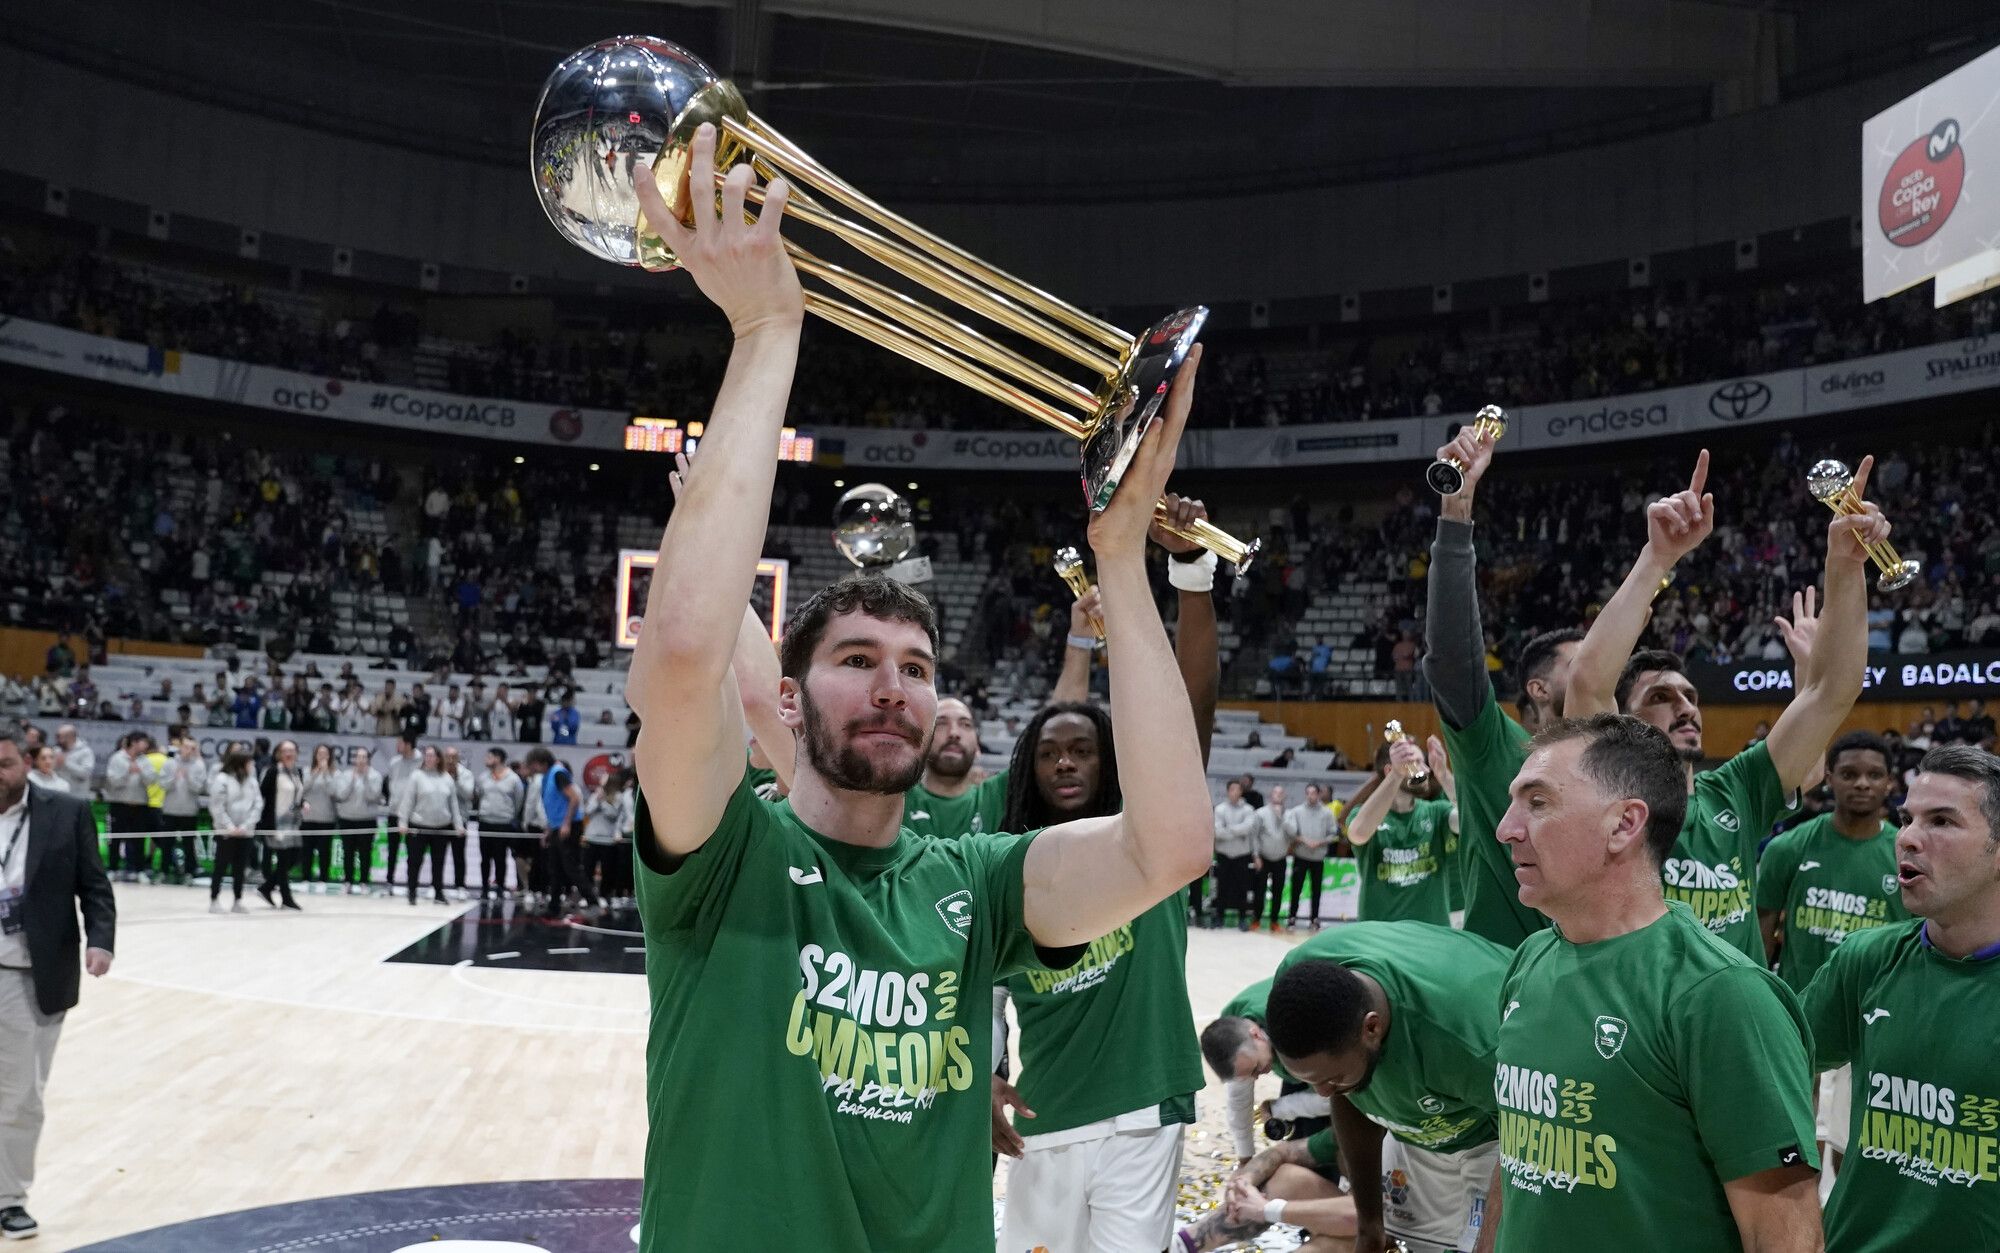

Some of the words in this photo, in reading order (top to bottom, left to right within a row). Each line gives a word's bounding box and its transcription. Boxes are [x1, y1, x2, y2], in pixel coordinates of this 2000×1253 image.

[1892, 176, 1935, 207] Copa
[1820, 370, 1885, 394] divina
[272, 386, 330, 412] acb
[369, 391, 517, 428] #CopaACB
[1546, 402, 1669, 438] endesa
[863, 441, 916, 464] acb
[1733, 669, 1793, 692] COPA
[1805, 886, 1867, 916] S2MOS
[858, 1079, 915, 1108] DEL
[1494, 1062, 1558, 1119] 2MOS
[1560, 1079, 1598, 1101] 22
[1867, 1071, 1956, 1126] 2MOS
[1560, 1100, 1593, 1124] 23
[1960, 1094, 2000, 1114] 22
[1959, 1111, 1999, 1132] 23
[1859, 1109, 2000, 1182] AMPEONE
[1861, 1145, 1908, 1168] COPA
[1910, 1154, 1939, 1175] DEL
[1938, 1166, 1982, 1188] REY
[1542, 1168, 1581, 1194] REY
